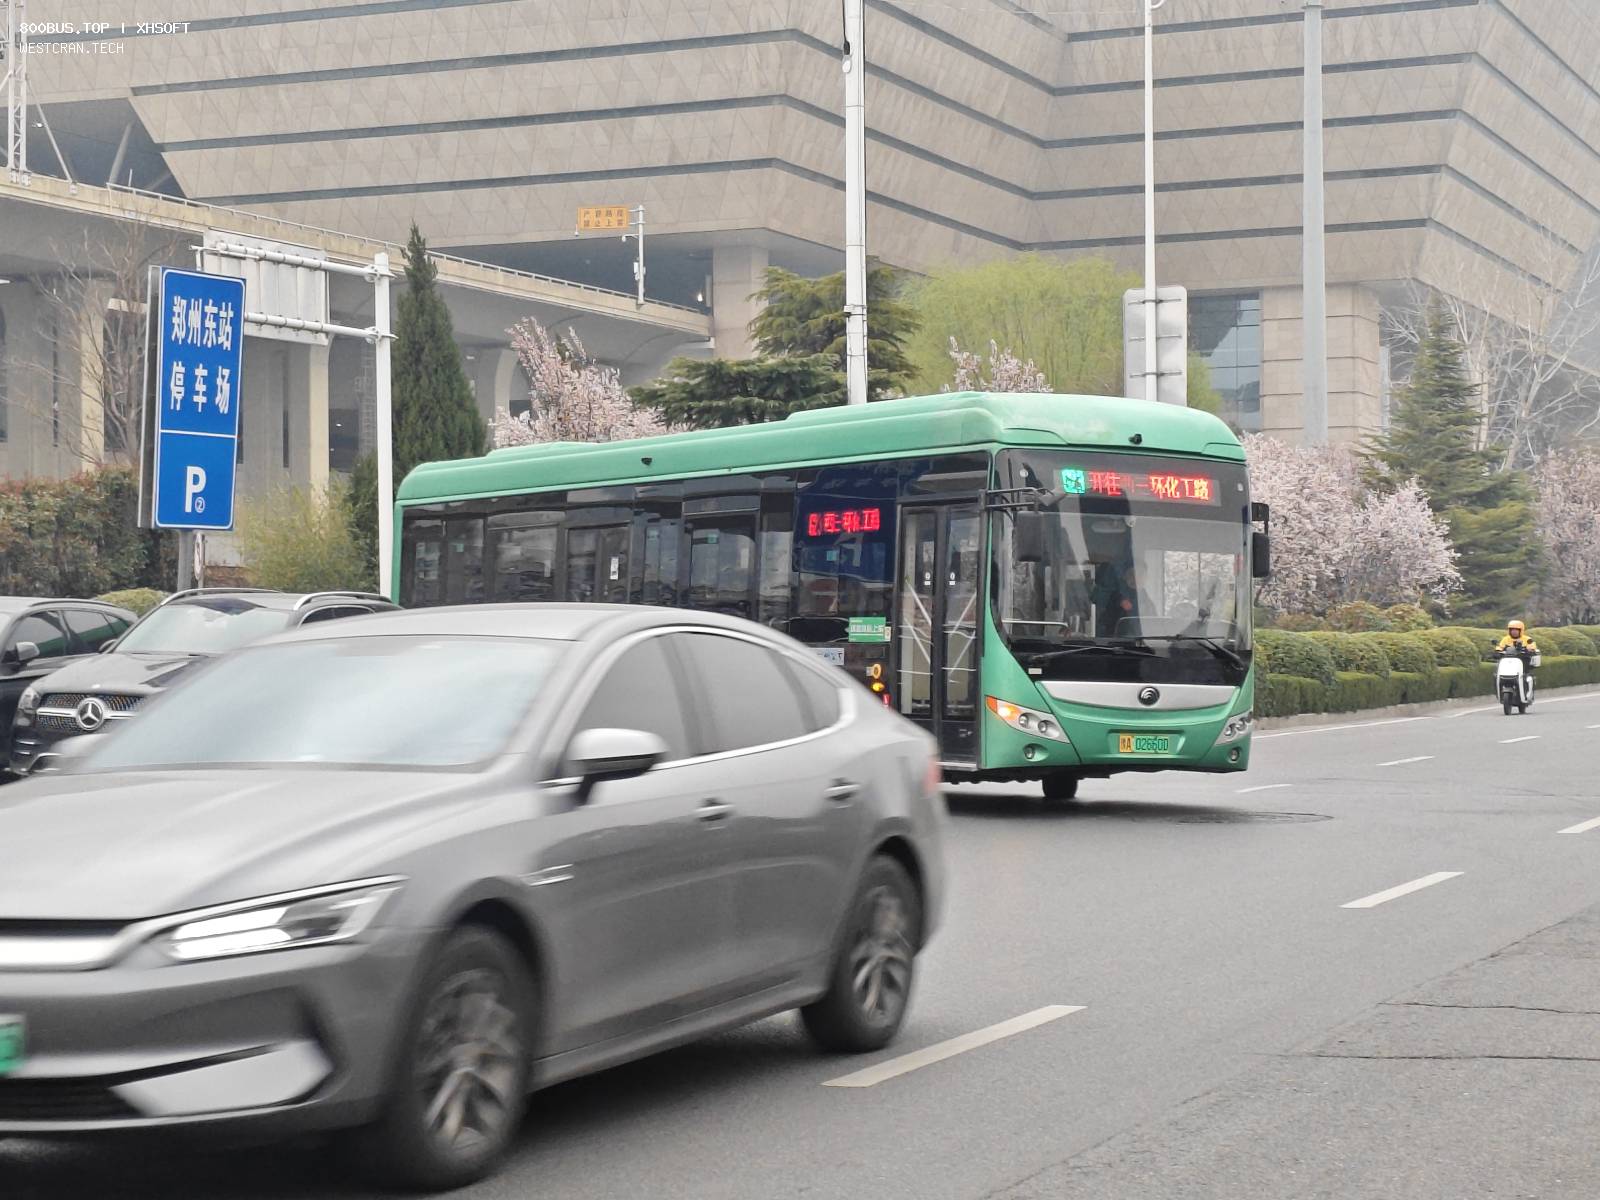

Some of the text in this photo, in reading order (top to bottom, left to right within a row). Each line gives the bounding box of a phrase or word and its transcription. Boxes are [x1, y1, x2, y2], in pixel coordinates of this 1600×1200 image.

[171, 296, 234, 351] 郑州东站
[170, 361, 231, 414] 停车场
[184, 465, 207, 513] P
